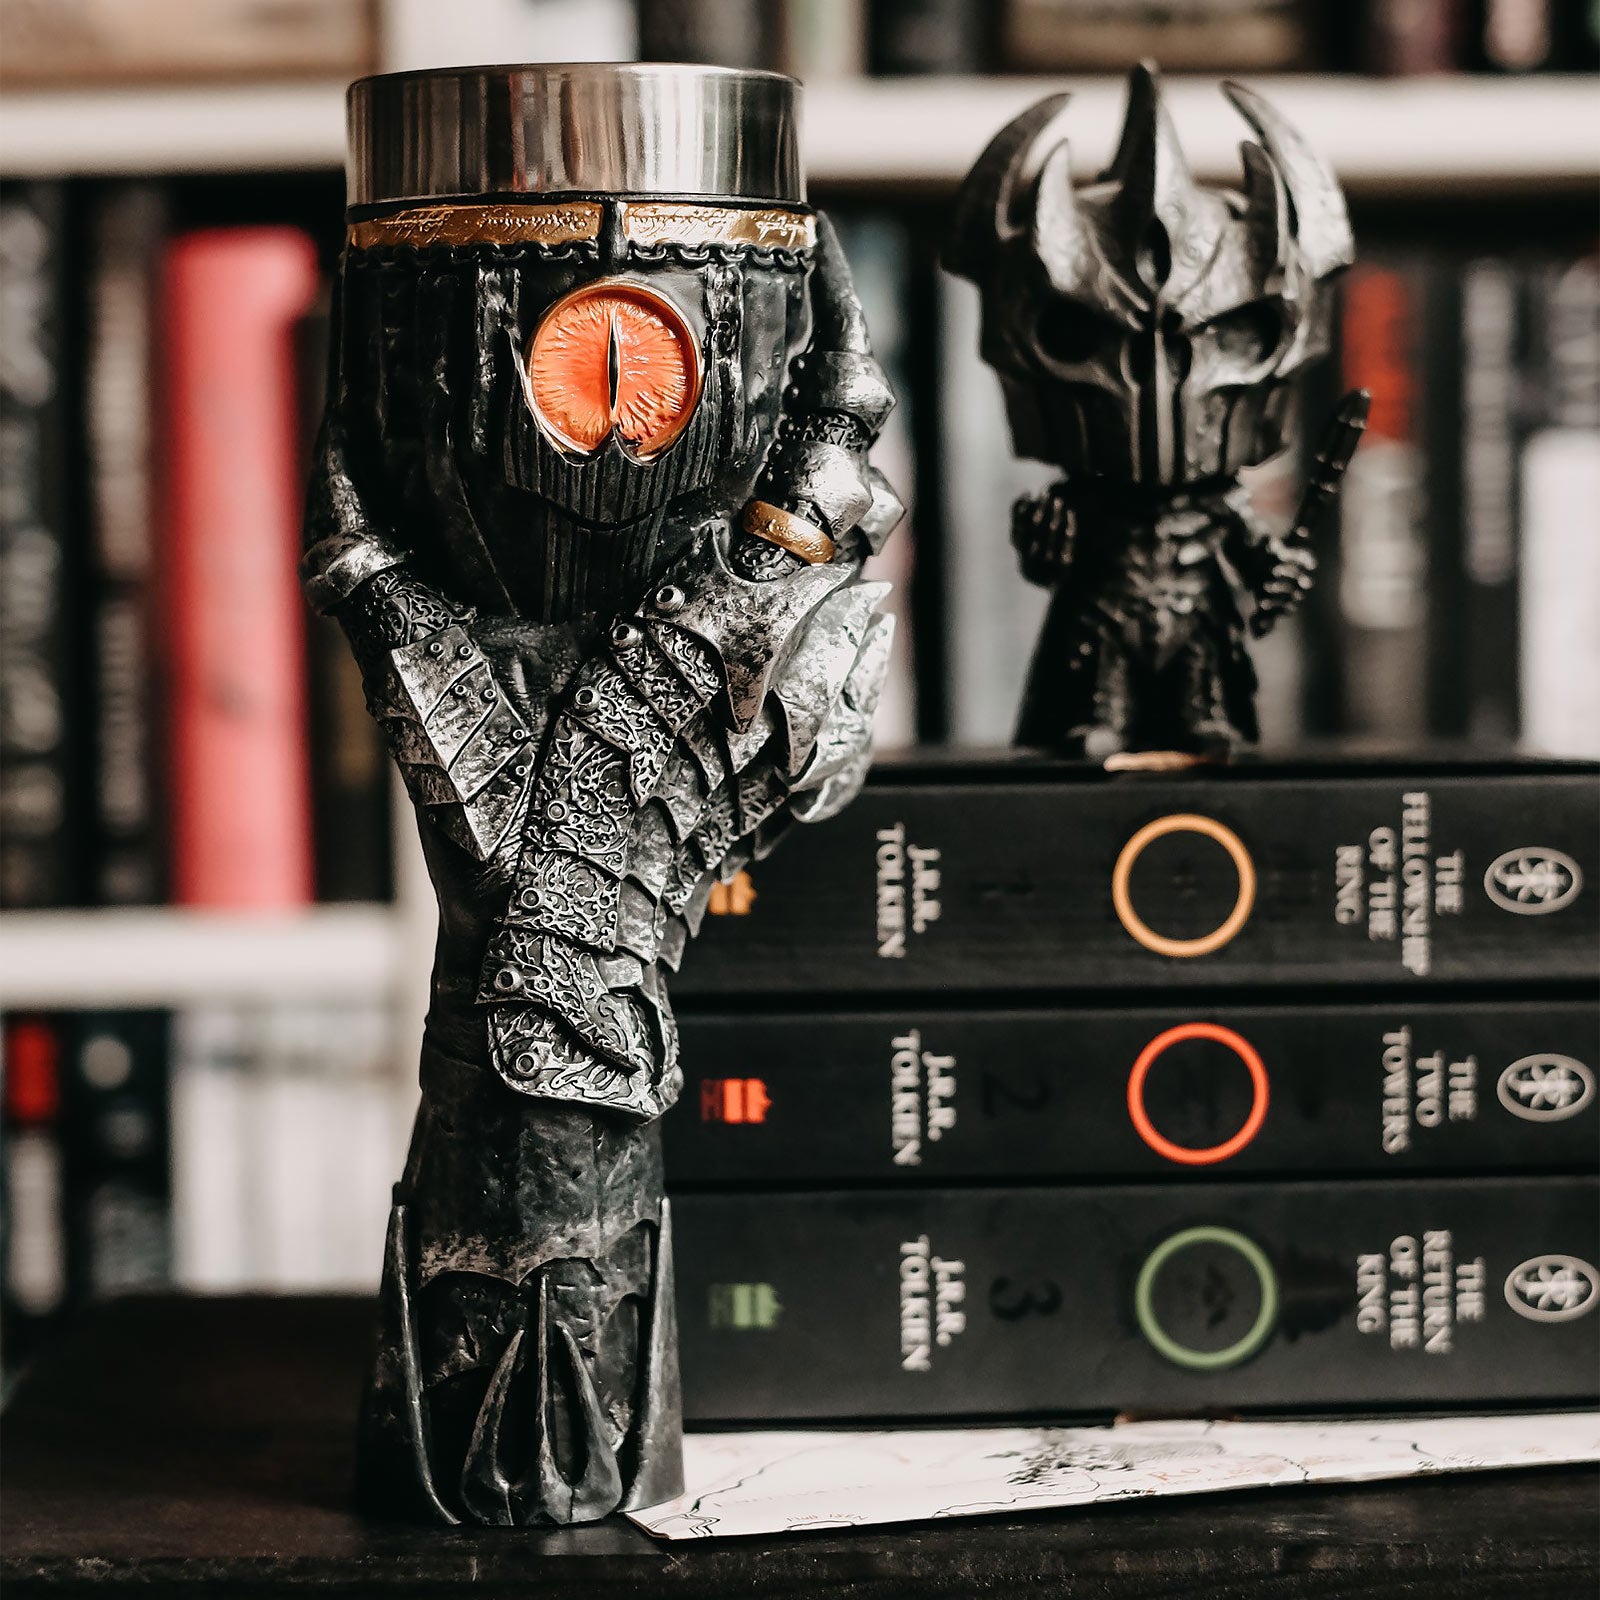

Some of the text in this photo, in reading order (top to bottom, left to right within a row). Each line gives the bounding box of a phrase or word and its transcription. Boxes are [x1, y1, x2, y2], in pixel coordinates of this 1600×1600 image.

[876, 822, 906, 959] TOLKIEN
[906, 844, 941, 934] J.R.R.
[1334, 845, 1363, 925] RING
[1368, 826, 1398, 941] OF THE
[1401, 791, 1432, 977] FELLOWSHIP
[1434, 850, 1464, 914] THE
[890, 1028, 922, 1165] TOLKIEN
[921, 1051, 957, 1142] J.R.R.
[1382, 1026, 1410, 1154] TOWERS
[1415, 1051, 1444, 1128] TWO
[1448, 1056, 1477, 1120] THE
[899, 1234, 932, 1372] TOLKIEN
[930, 1255, 967, 1347] J.R.R.
[987, 1276, 1064, 1323] 3
[1356, 1253, 1386, 1334] KING
[1389, 1235, 1420, 1350] OF THE
[1422, 1229, 1454, 1355] RETURN
[1455, 1256, 1486, 1322] THE
